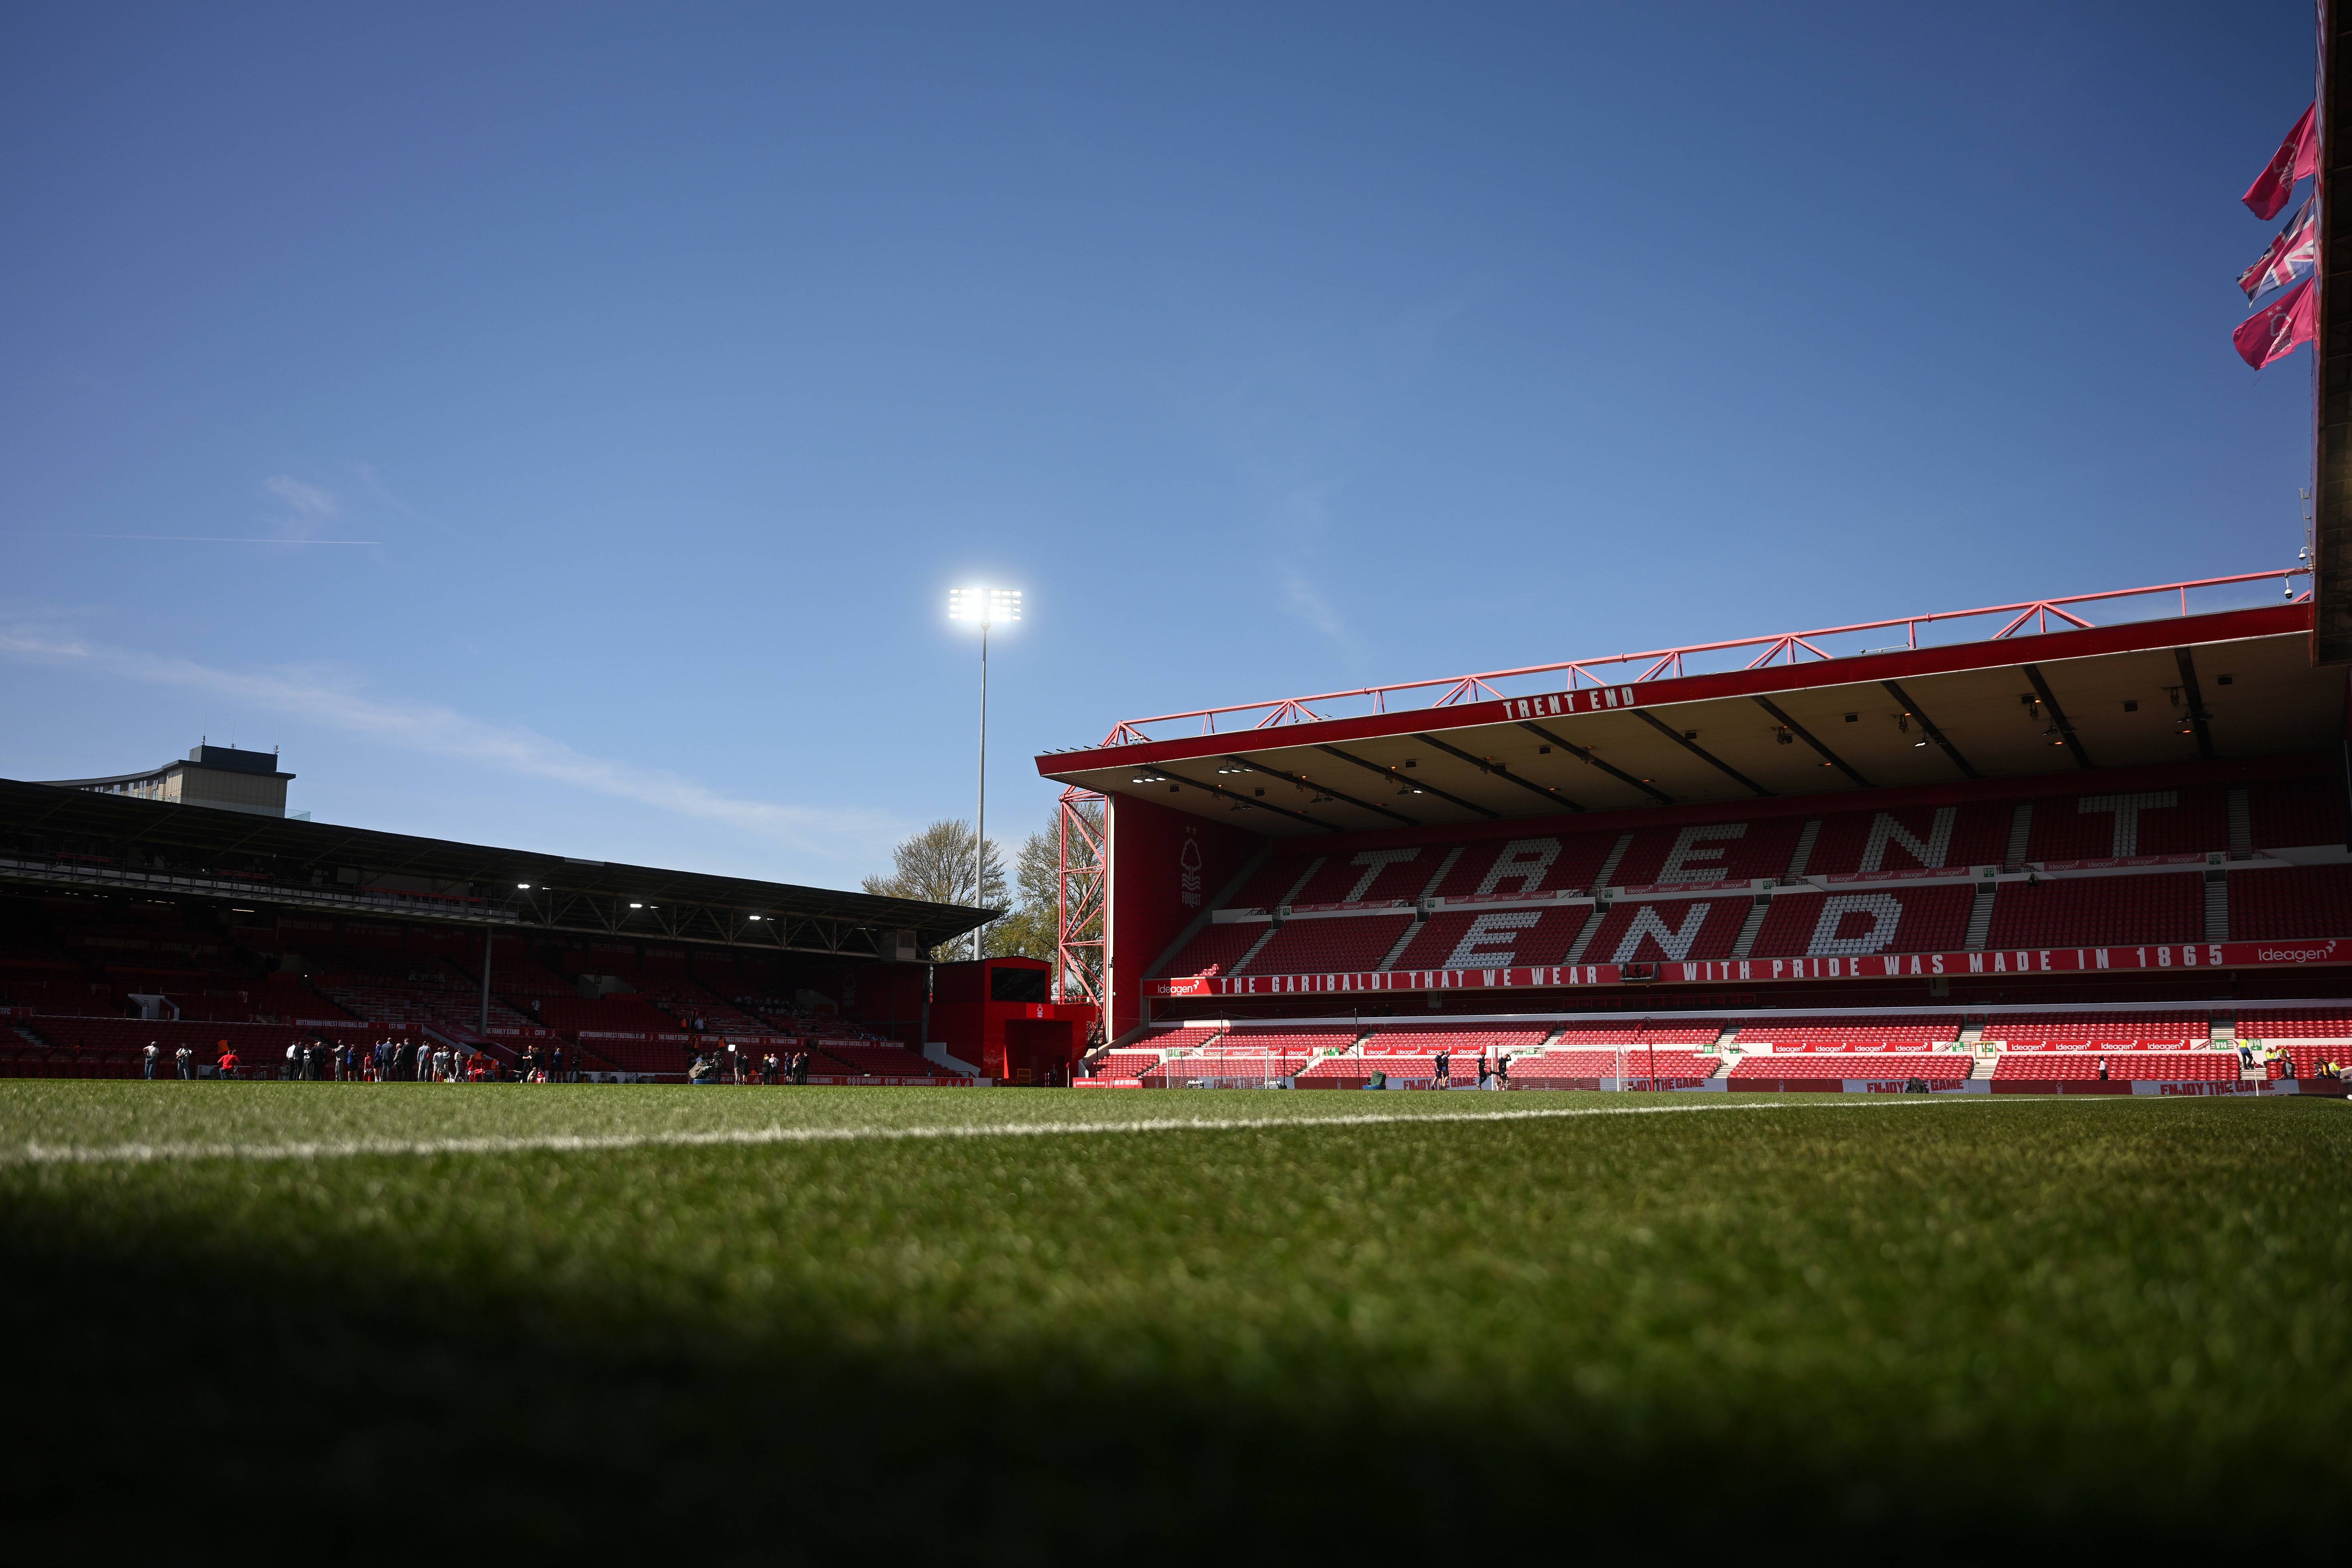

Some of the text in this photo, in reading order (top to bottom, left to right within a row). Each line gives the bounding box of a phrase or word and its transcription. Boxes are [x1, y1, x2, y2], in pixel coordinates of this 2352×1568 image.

[1503, 687, 1634, 719] TRENT END
[1342, 790, 2178, 903] TRENT
[293, 921, 310, 929] MADE
[311, 922, 317, 930] IN
[1441, 894, 1902, 969] END
[1683, 944, 2327, 980] WITH PRIDE WAS MADE IN 1865 Ideagen
[1158, 966, 1596, 995] Ideagen THE GARIBALDI THAT WE WEAR
[2011, 1044, 2042, 1052] Ideagen
[2101, 1043, 2133, 1051] Ideagen
[2147, 1042, 2181, 1050] Ideagen
[1403, 1079, 1432, 1090] ENJOY
[1451, 1077, 1476, 1087] GAME
[1675, 1078, 1705, 1089] GAME
[1867, 1081, 1904, 1093] ENJOY
[1931, 1079, 1964, 1091] GAME
[2160, 1080, 2275, 1095] ENJOY THE GAME
